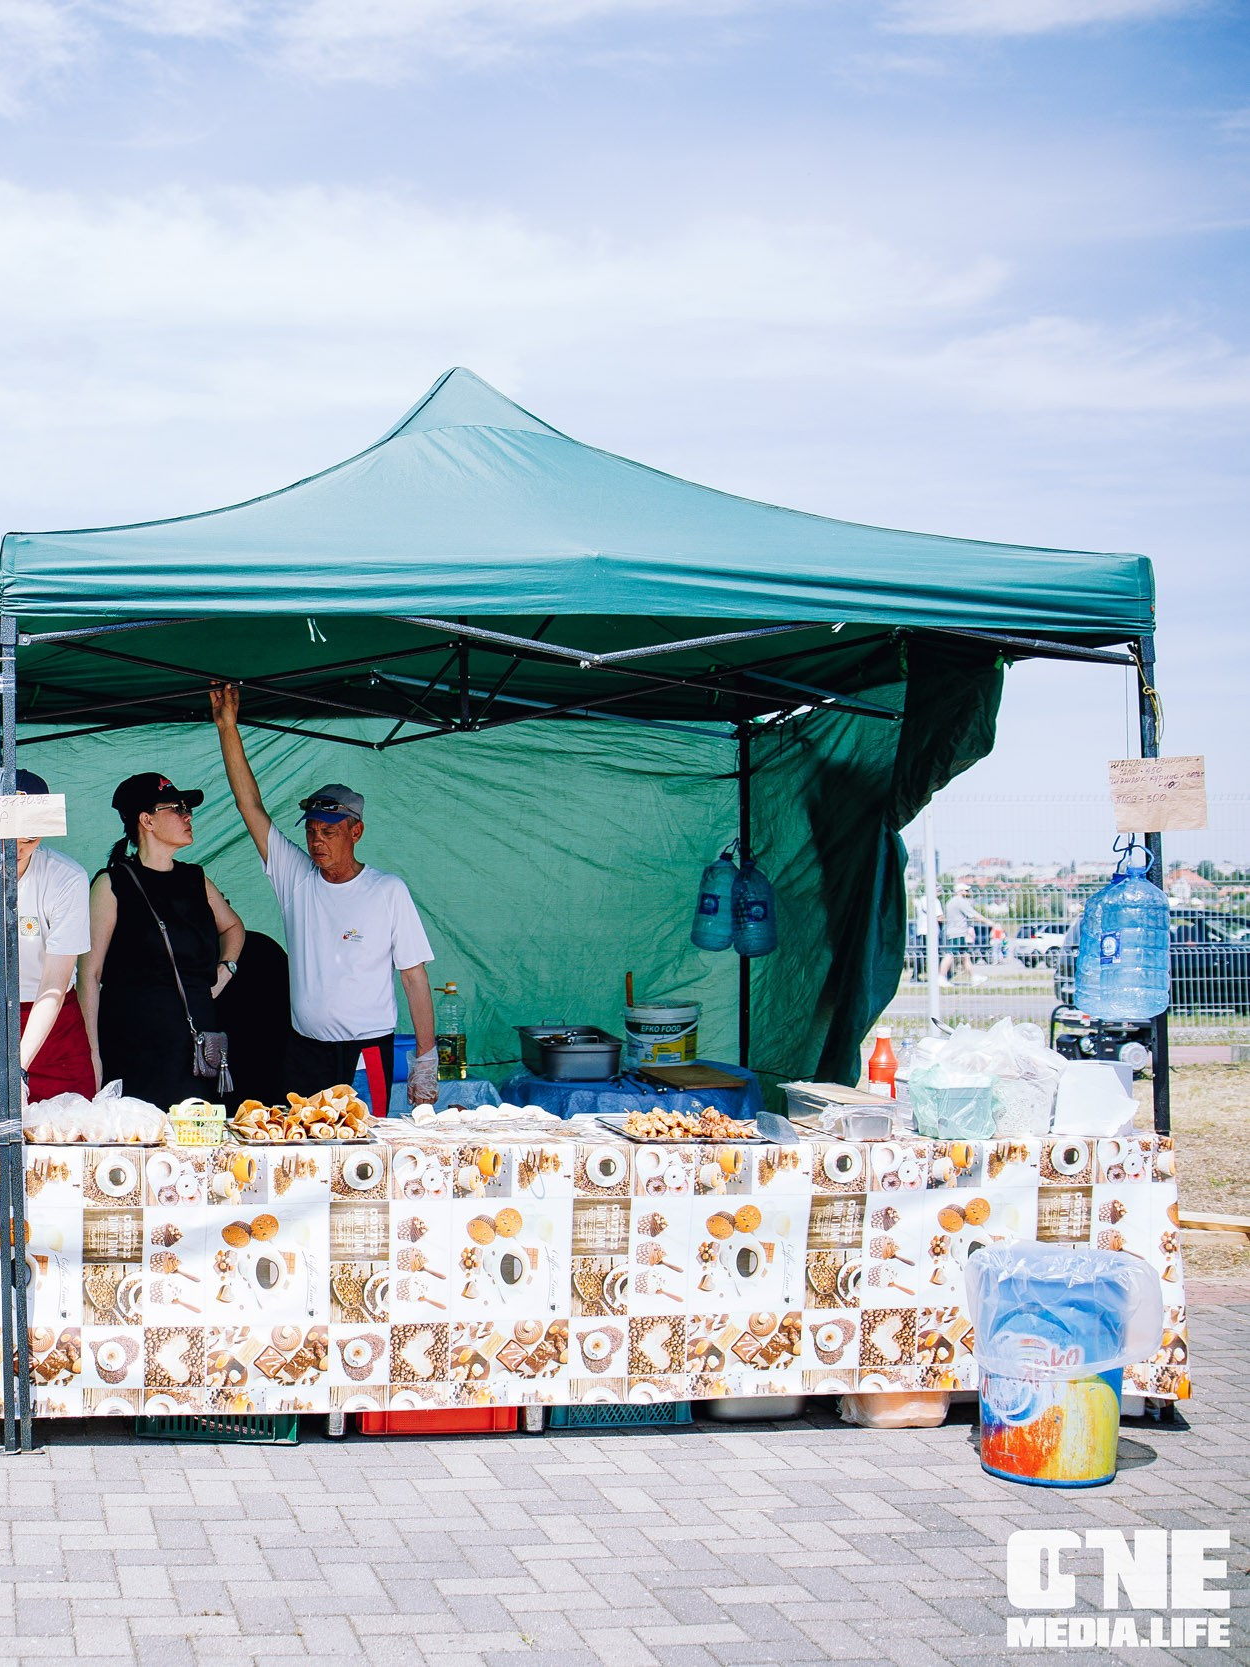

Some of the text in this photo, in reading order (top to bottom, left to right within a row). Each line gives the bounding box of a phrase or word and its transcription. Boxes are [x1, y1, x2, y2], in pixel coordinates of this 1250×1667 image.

[610, 1204, 619, 1249] COFFEE
[844, 1200, 855, 1243] COFFEE
[1058, 1216, 1068, 1234] DENY
[1073, 1192, 1082, 1236] COFFEE
[123, 1215, 131, 1258] COFFEE
[354, 1233, 364, 1253] DENY
[370, 1208, 378, 1255] COFFEE
[595, 1228, 606, 1247] DENY
[829, 1223, 840, 1241] DENY
[107, 1239, 118, 1256] DENY
